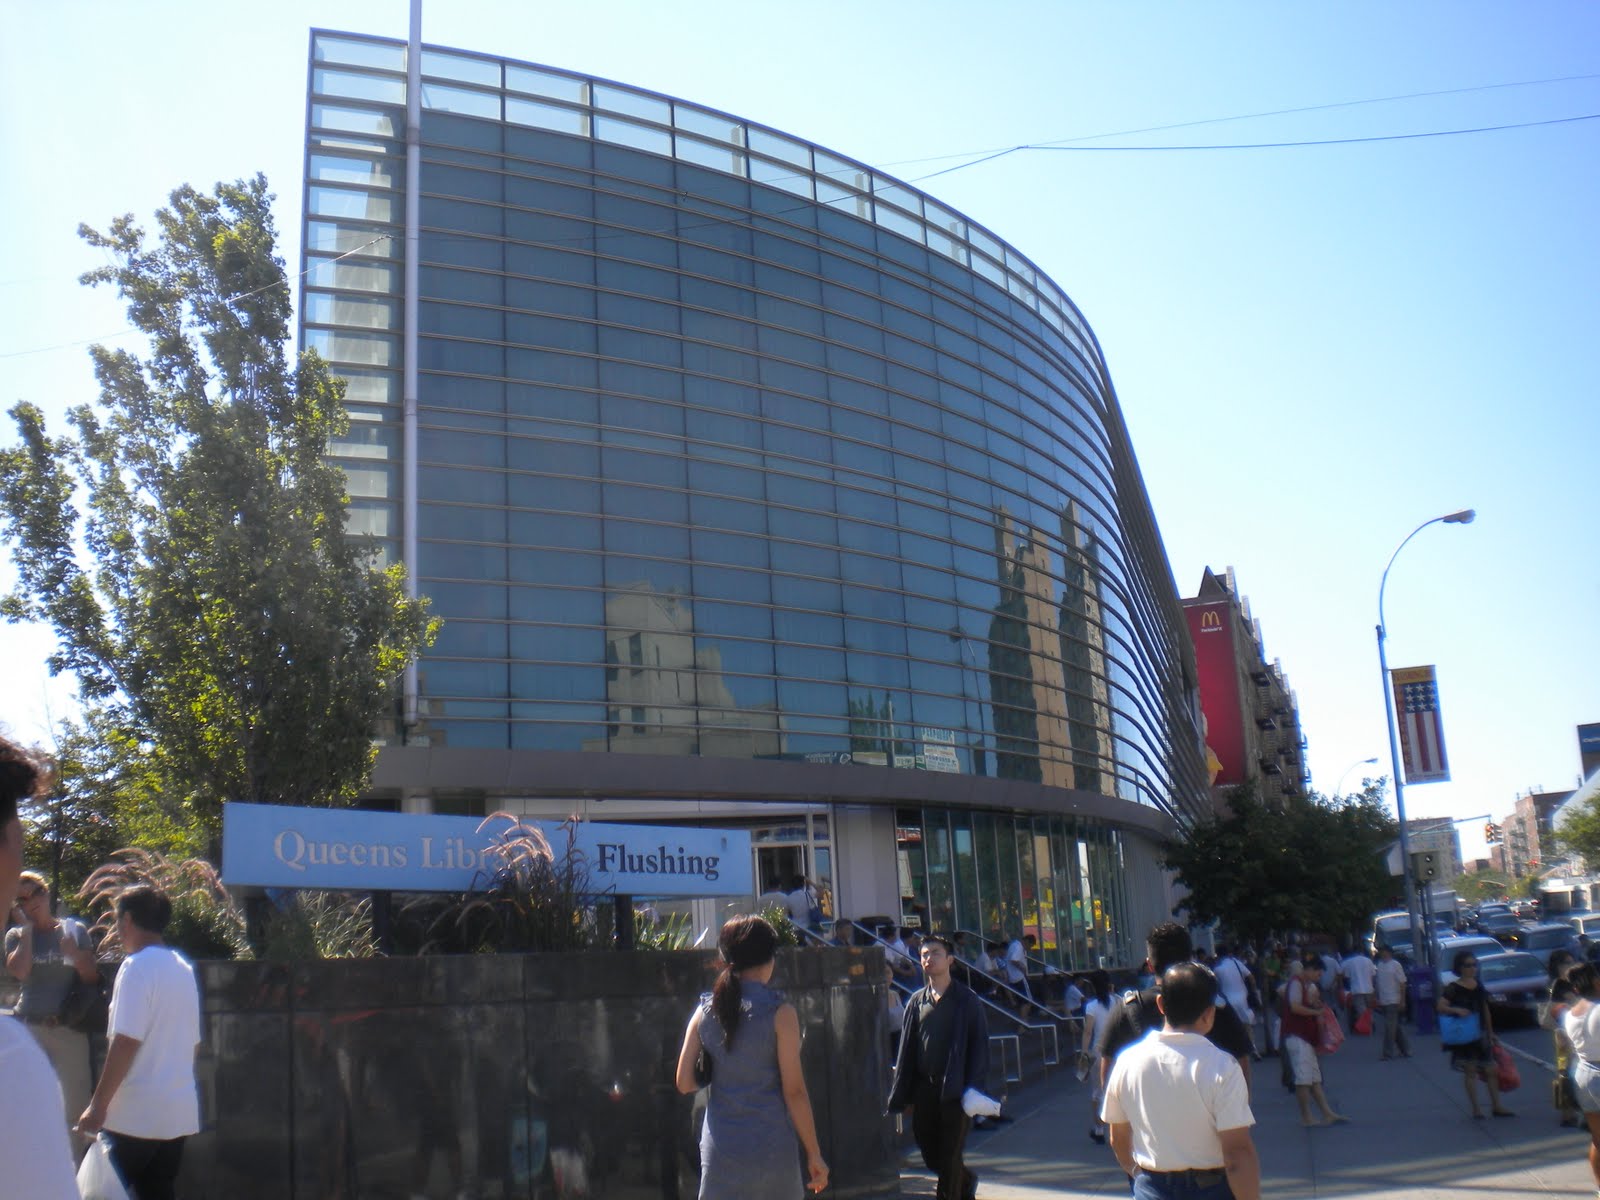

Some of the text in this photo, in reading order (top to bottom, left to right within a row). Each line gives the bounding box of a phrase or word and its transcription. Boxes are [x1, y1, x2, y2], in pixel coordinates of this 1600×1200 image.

[273, 829, 720, 881] Queens Libr Flushing
